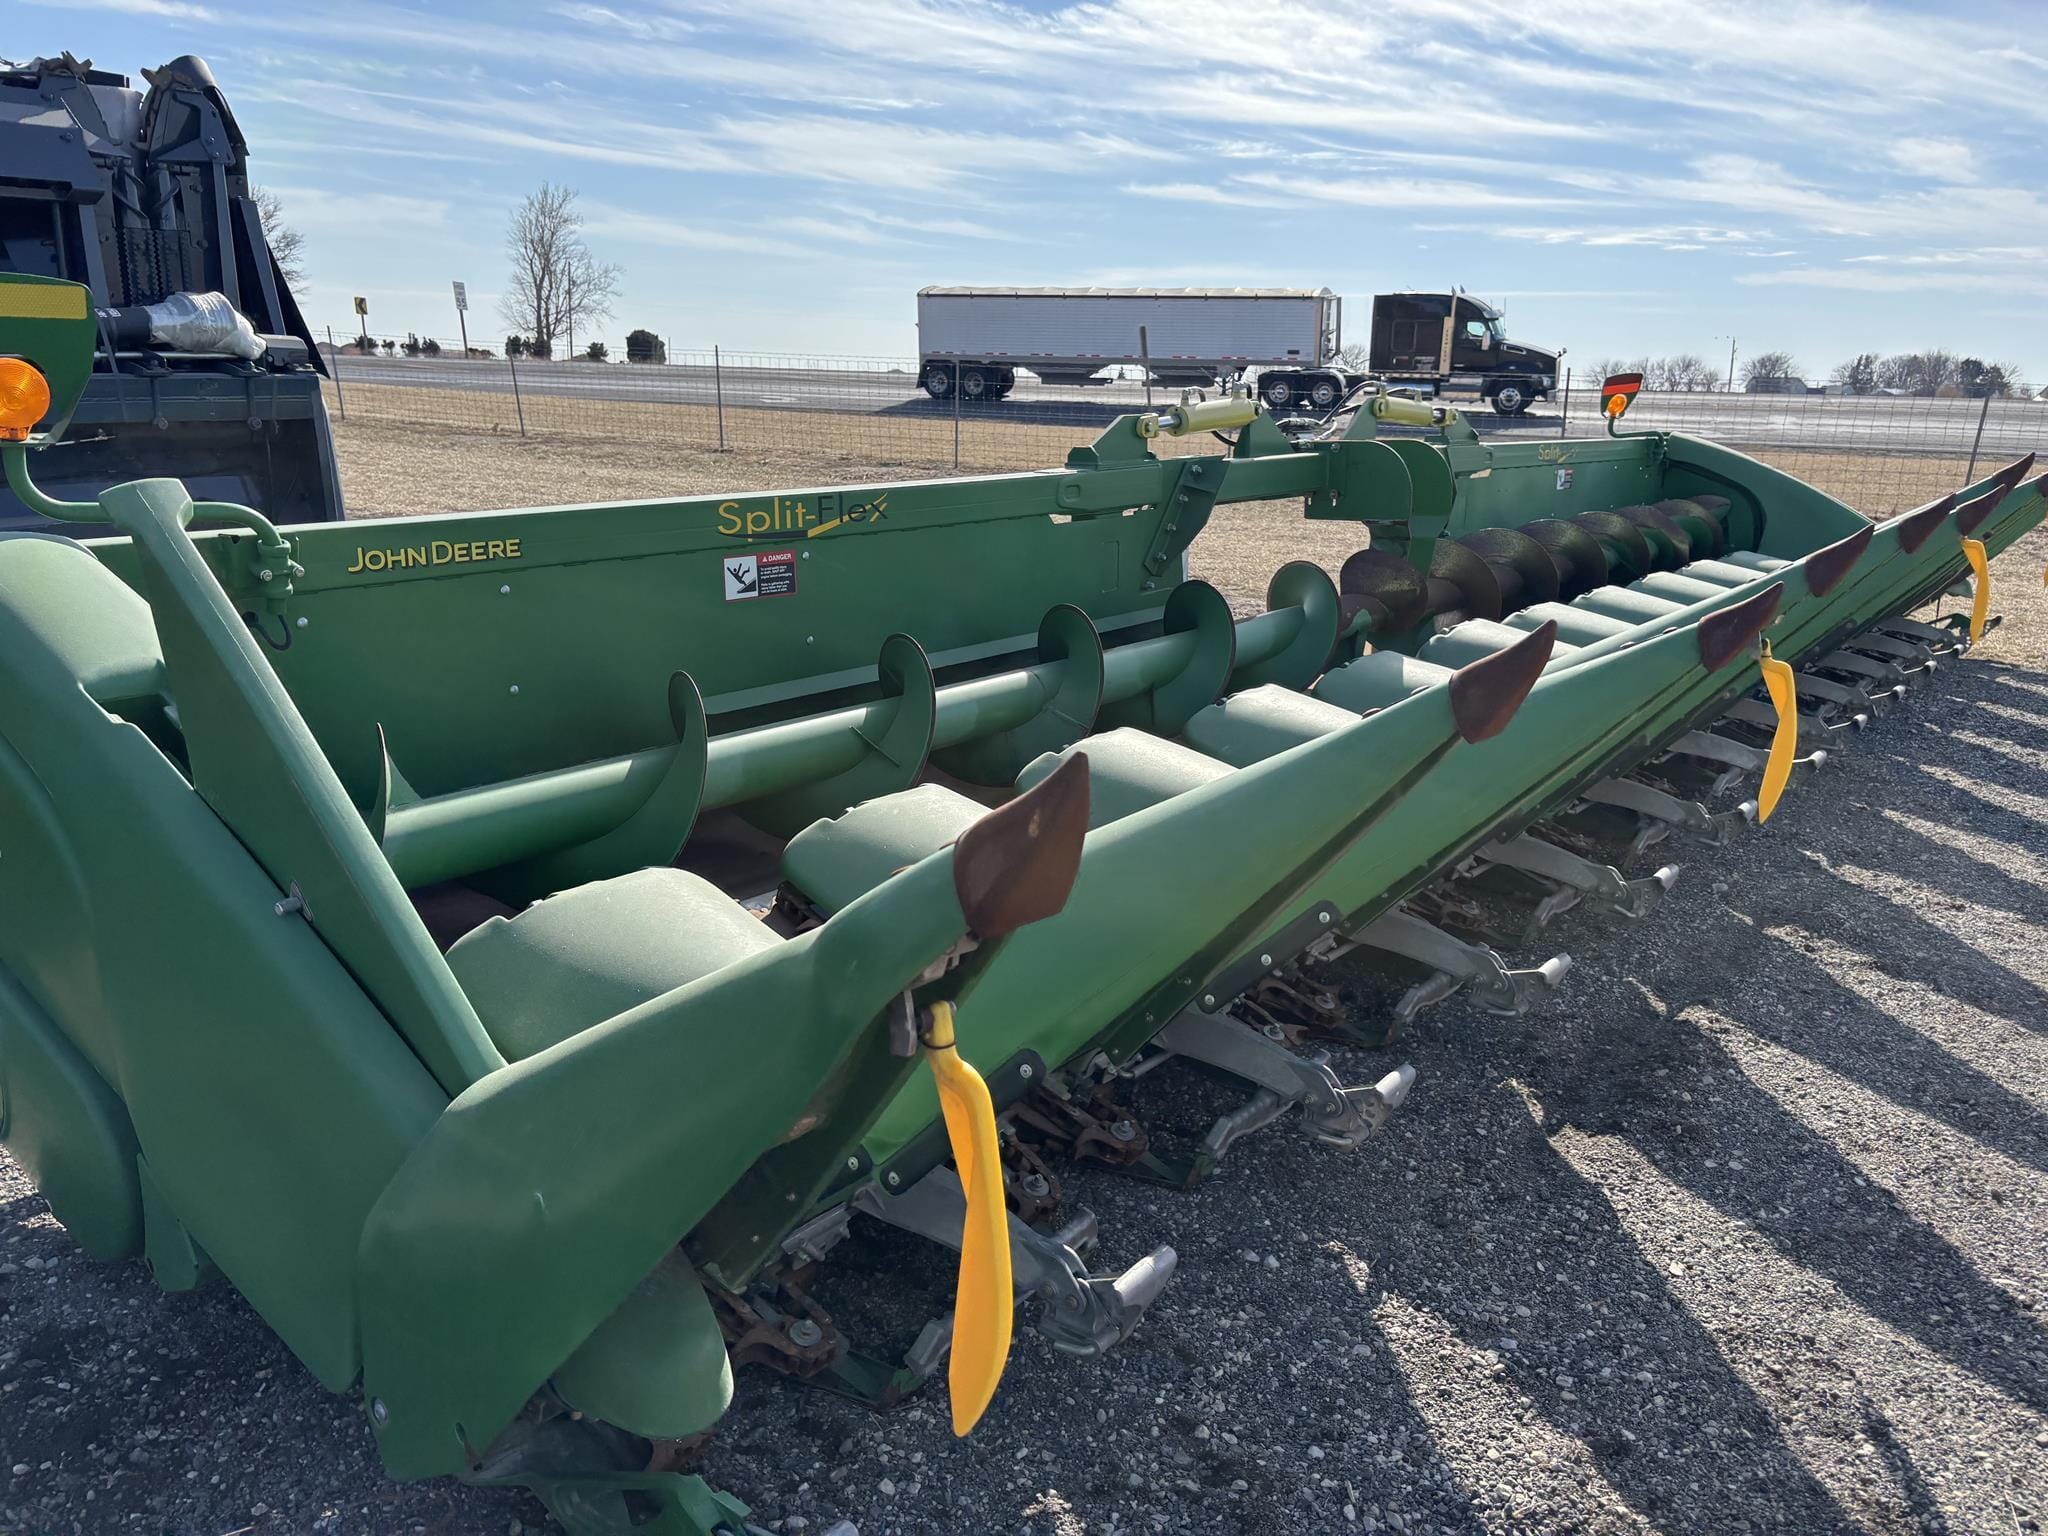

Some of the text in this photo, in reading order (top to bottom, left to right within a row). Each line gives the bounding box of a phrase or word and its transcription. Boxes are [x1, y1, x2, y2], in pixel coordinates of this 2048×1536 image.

[718, 491, 888, 542] Split-Flex
[348, 538, 521, 573] JOHN DEERE
[768, 553, 792, 562] DANGER
